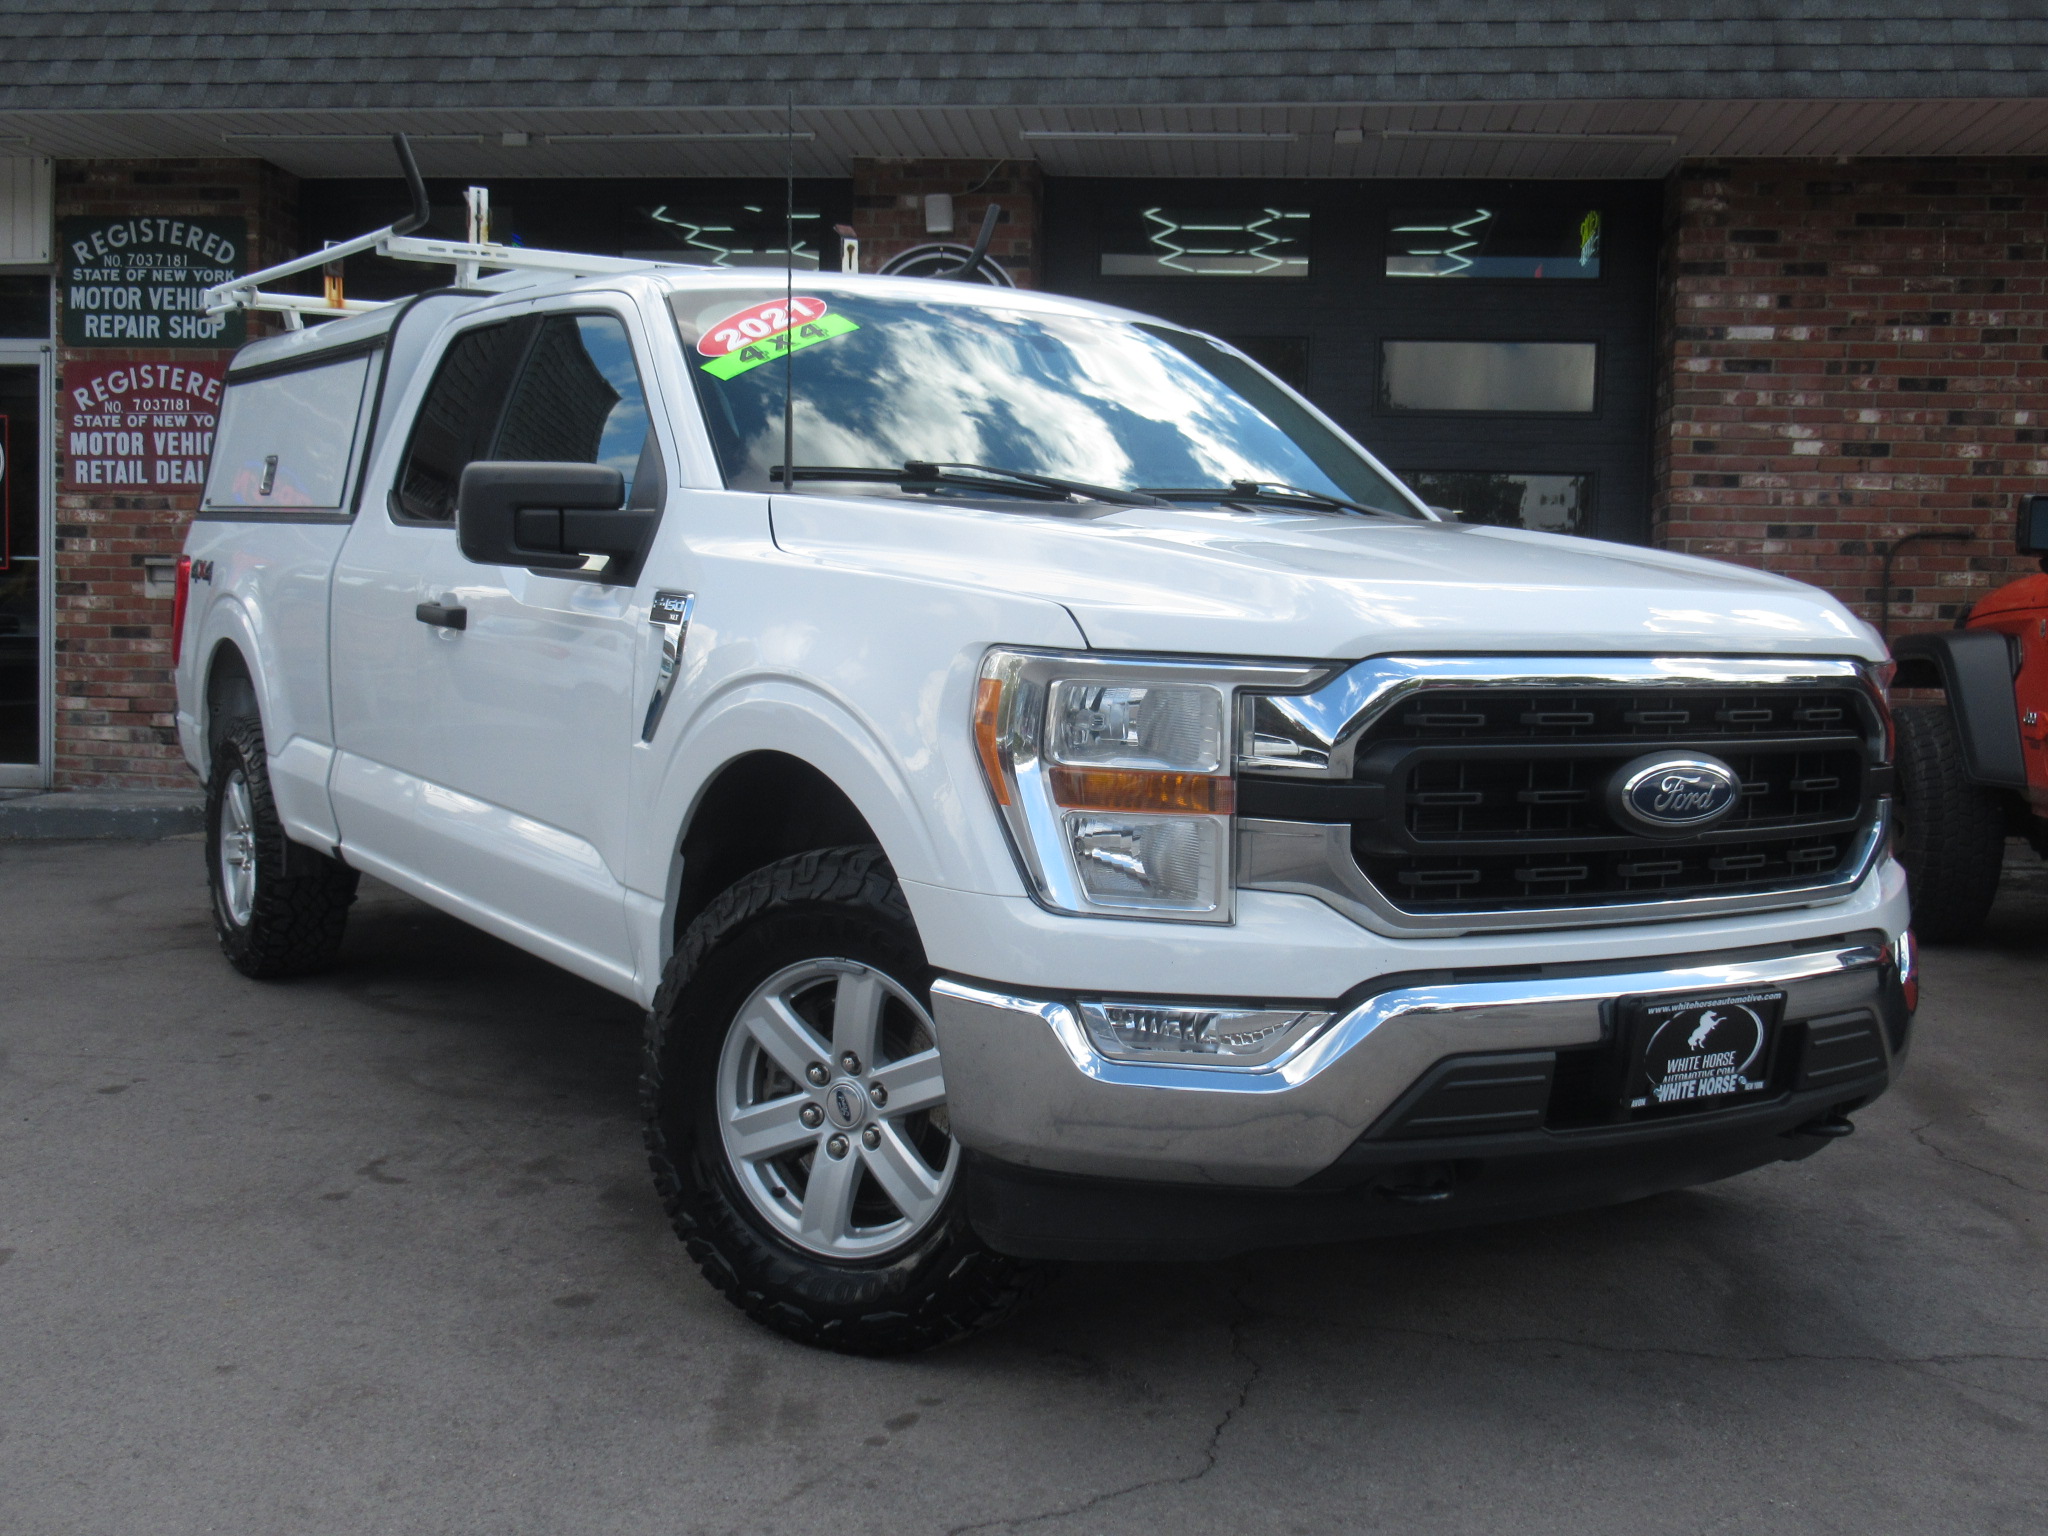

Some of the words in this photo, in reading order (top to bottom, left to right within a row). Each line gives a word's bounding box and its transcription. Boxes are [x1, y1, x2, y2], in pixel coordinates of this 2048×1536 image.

[72, 218, 236, 265] REGISTERED
[103, 255, 122, 267] NO.
[127, 253, 188, 267] 7037181
[72, 268, 120, 281] STATE
[126, 269, 147, 282] OF
[152, 269, 187, 282] NEW
[192, 269, 235, 282] YORK
[70, 286, 142, 310] MOTOR
[148, 287, 204, 311] VEHI
[85, 314, 160, 338] REPAIR
[169, 315, 226, 339] SHOP
[714, 299, 815, 352] 2021
[72, 364, 221, 412] REGISTERE
[104, 401, 123, 414] NO.
[132, 399, 190, 411] 7037181
[73, 414, 121, 427] STATE
[127, 415, 147, 427] OF
[153, 415, 188, 427] NEW
[193, 415, 215, 427] YO
[70, 432, 144, 456] MOTOR
[153, 432, 213, 456] VEHIC
[75, 460, 148, 484] RETAIL
[1653, 775, 1716, 812] Ford
[1648, 992, 1782, 1015] www.whitehorseautomotive.com
[1667, 1055, 1701, 1074] WHITE
[1702, 1050, 1736, 1069] HORSE
[1658, 1080, 1697, 1103] WHITE
[1697, 1074, 1738, 1097] HORSE
